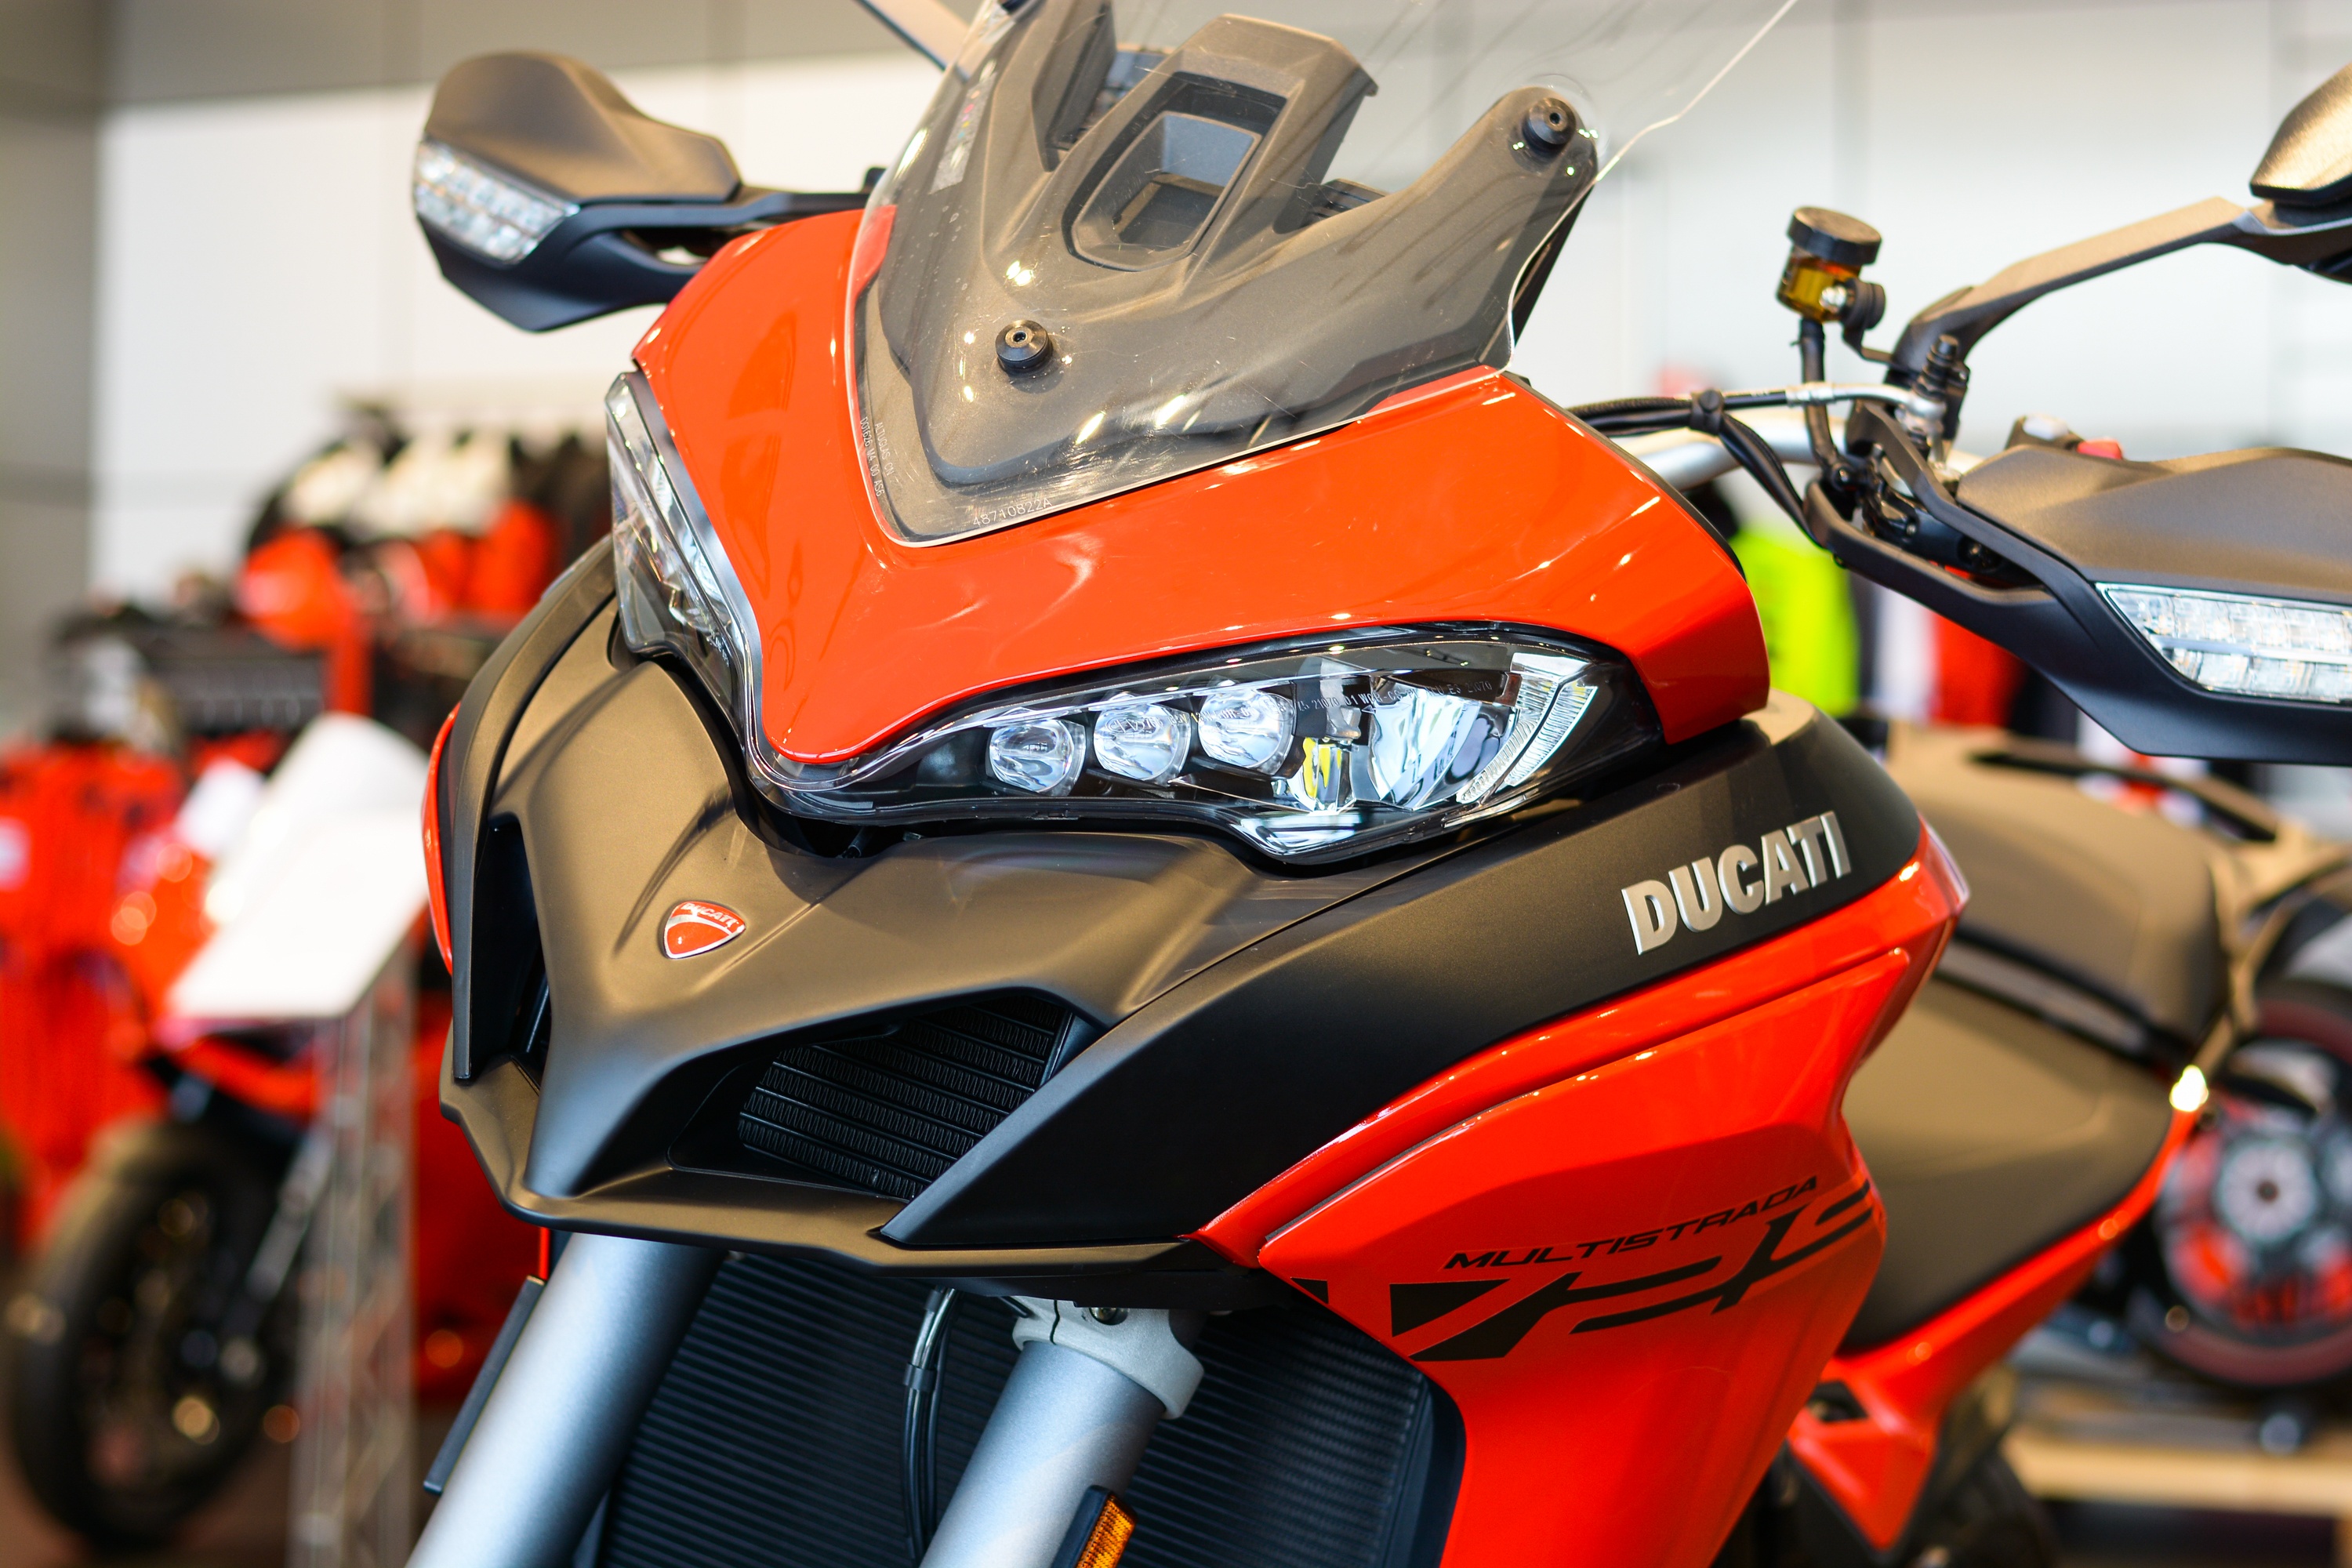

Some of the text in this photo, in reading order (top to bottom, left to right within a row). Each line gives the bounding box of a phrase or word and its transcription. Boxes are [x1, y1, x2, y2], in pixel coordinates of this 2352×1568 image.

[875, 422, 894, 476] ALTUGLAS CN
[973, 497, 1052, 527] 48710822A
[1311, 697, 1340, 709] 21070
[1621, 811, 1851, 956] DUCATI
[681, 902, 738, 928] DUCATI
[1444, 1176, 1817, 1270] MULTISTRADA
